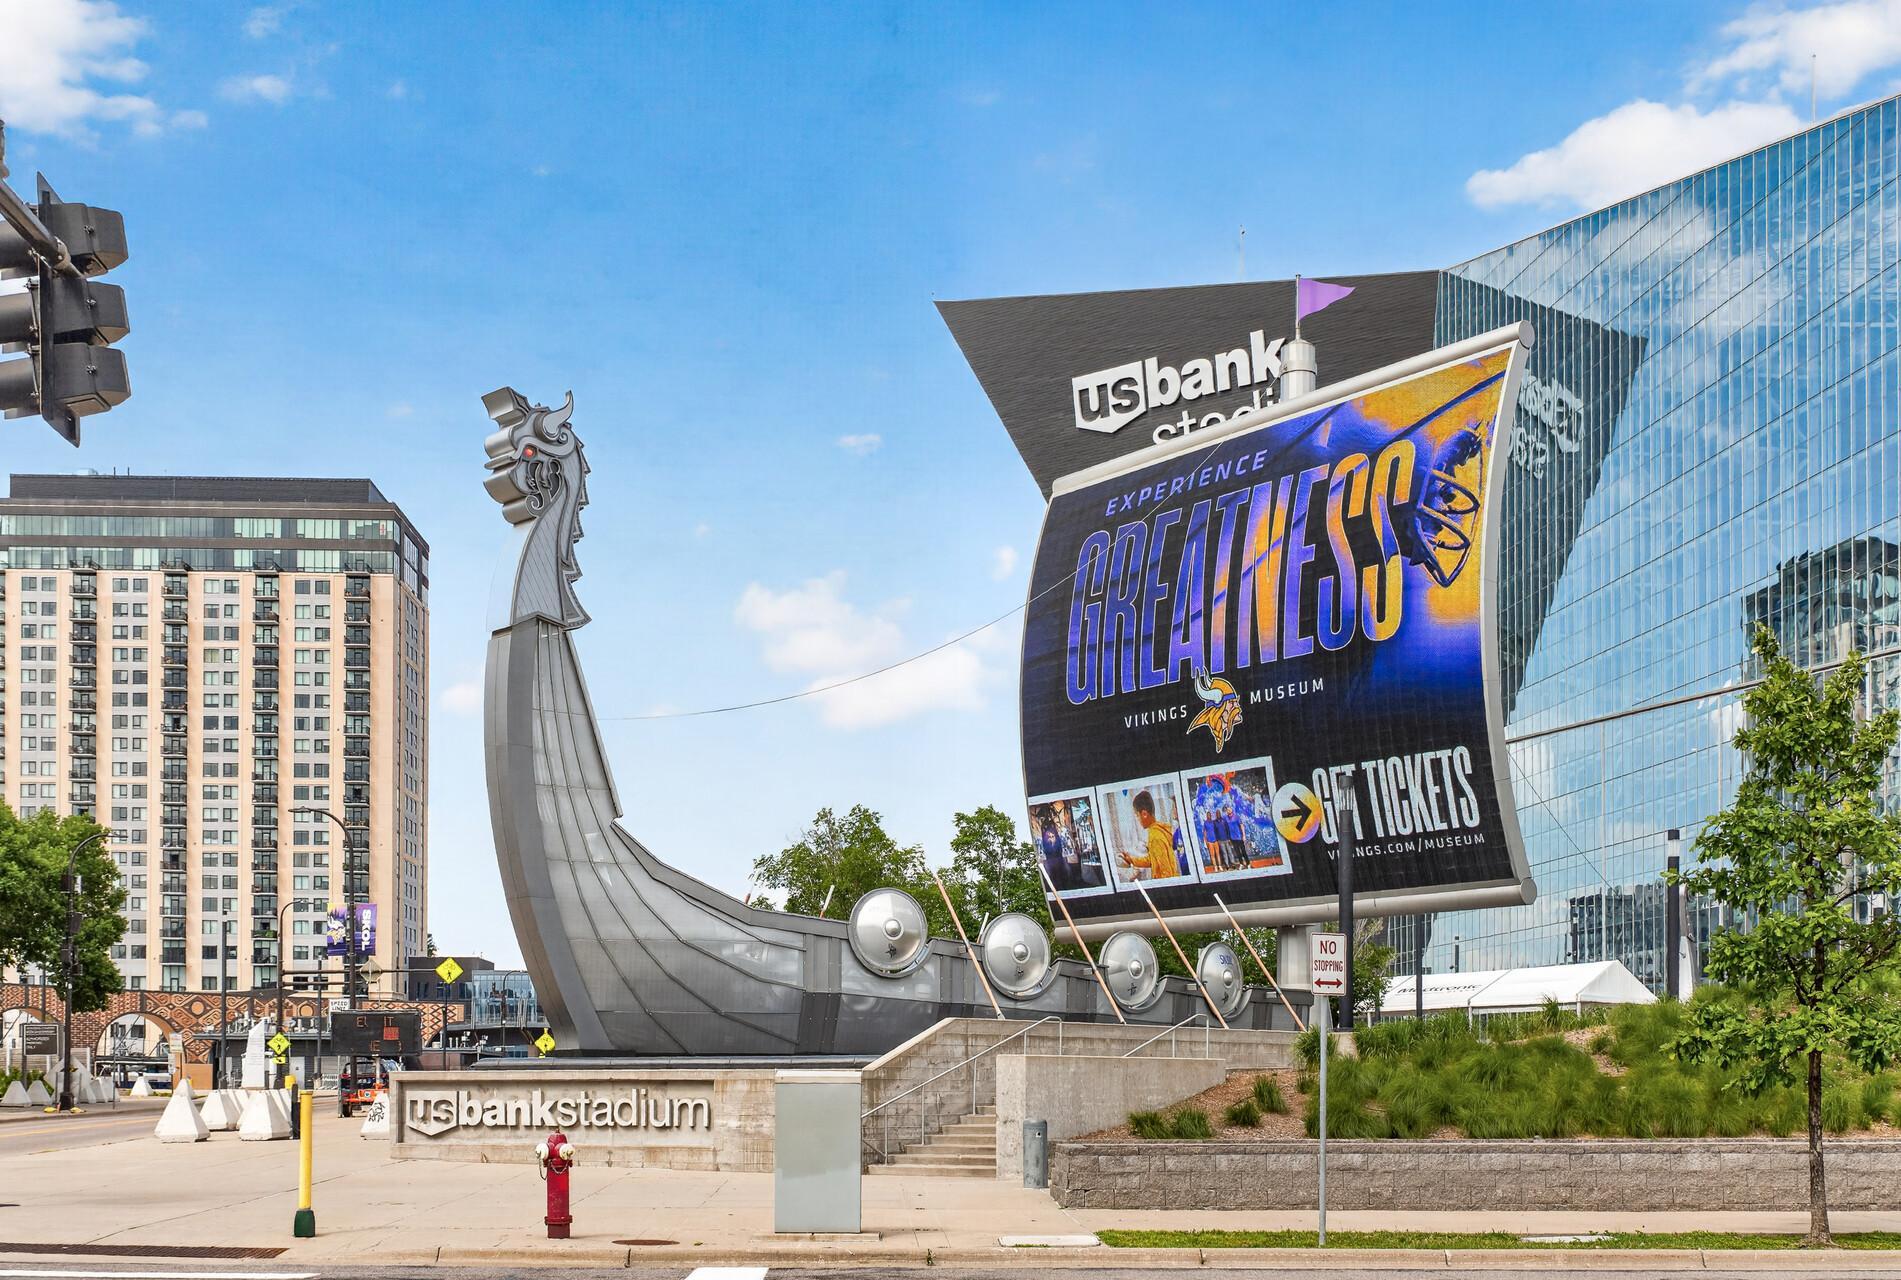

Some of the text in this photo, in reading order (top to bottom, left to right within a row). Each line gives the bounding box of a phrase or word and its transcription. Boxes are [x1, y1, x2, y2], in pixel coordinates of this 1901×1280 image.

[1105, 449, 1268, 517] EXPERIENCE
[1066, 439, 1416, 705] GREATNESS
[1124, 677, 1324, 729] VIKINGS MUSEUM
[1361, 745, 1481, 838] TICKETS
[1327, 833, 1485, 861] VINGS.COM/MUSEUM
[362, 909, 372, 951] SKOL
[1319, 940, 1337, 955] NO
[1313, 959, 1344, 973] STOPPING
